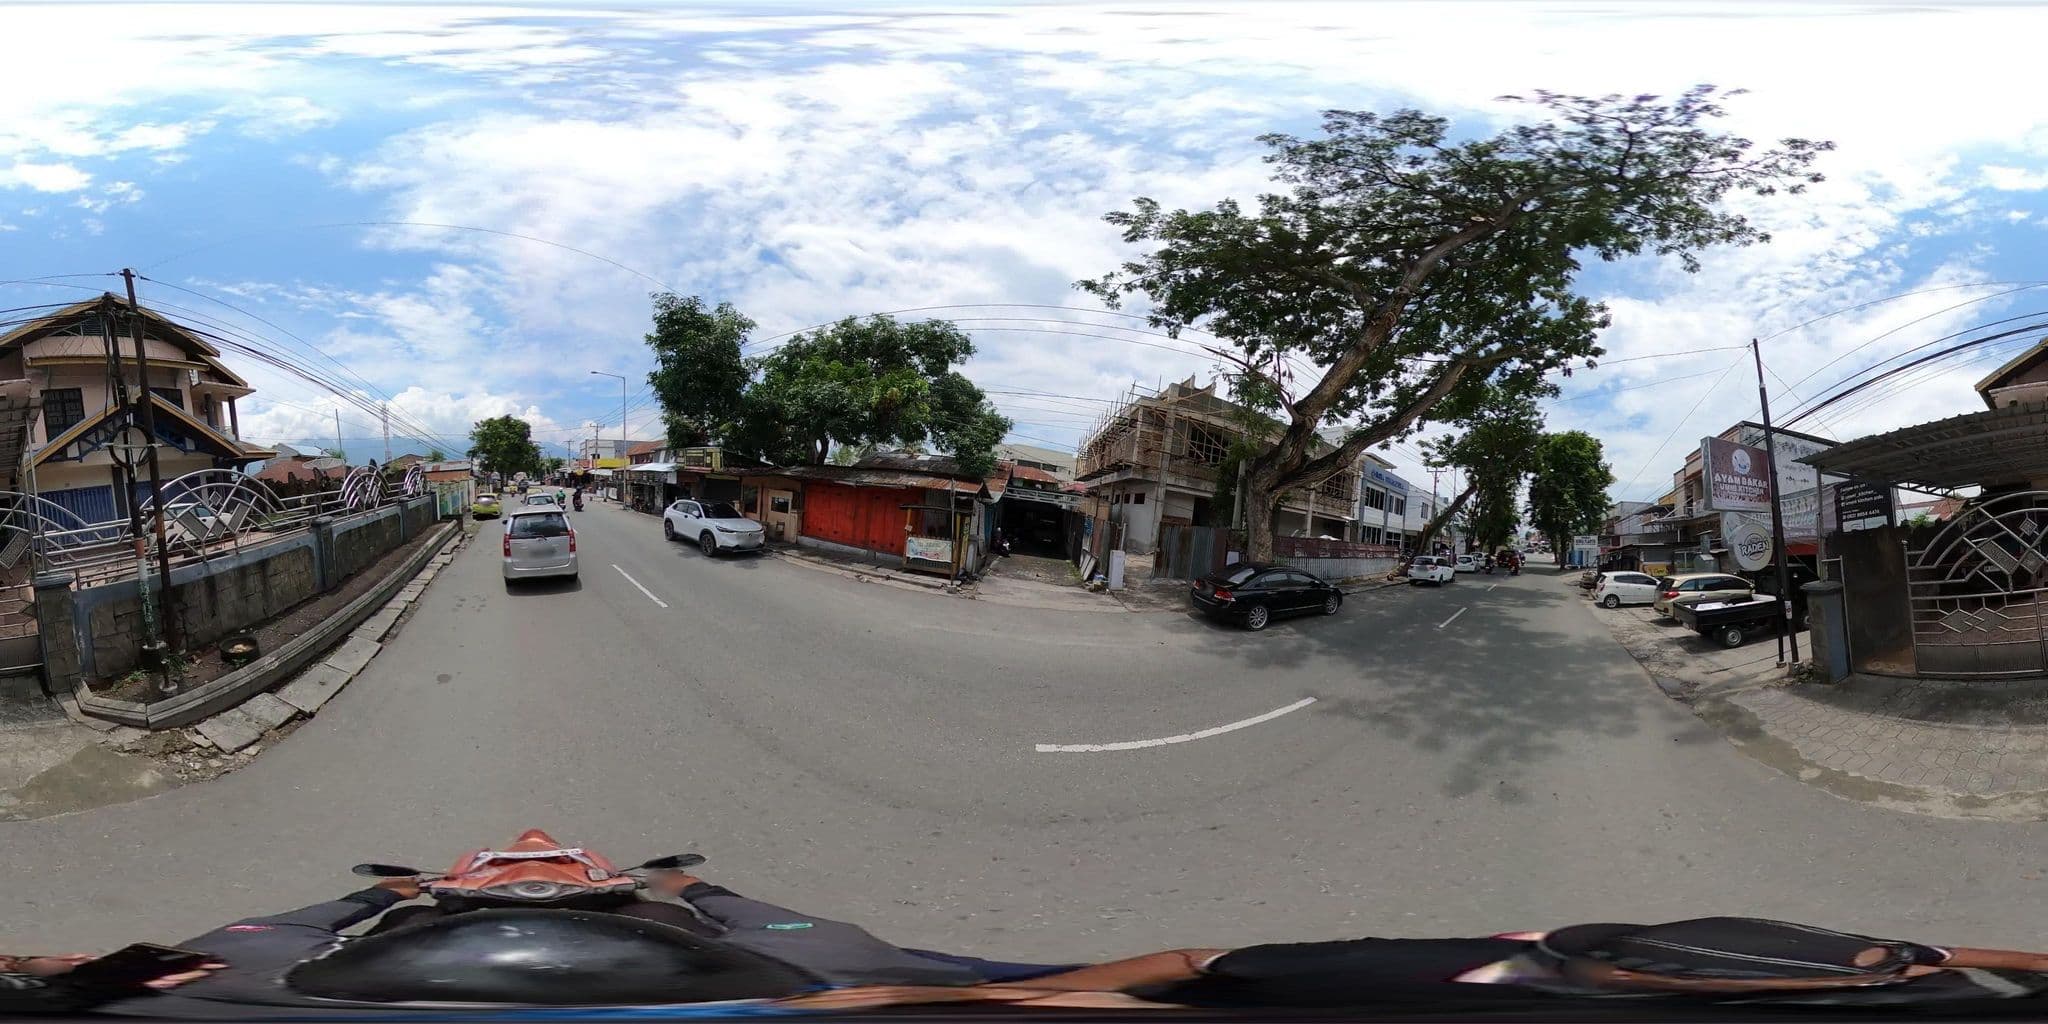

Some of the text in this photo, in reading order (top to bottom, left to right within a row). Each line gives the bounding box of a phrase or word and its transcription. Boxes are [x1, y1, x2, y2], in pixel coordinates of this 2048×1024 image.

[1714, 473, 1768, 489] AYAM BAKAR
[1738, 539, 1769, 557] RADEN
